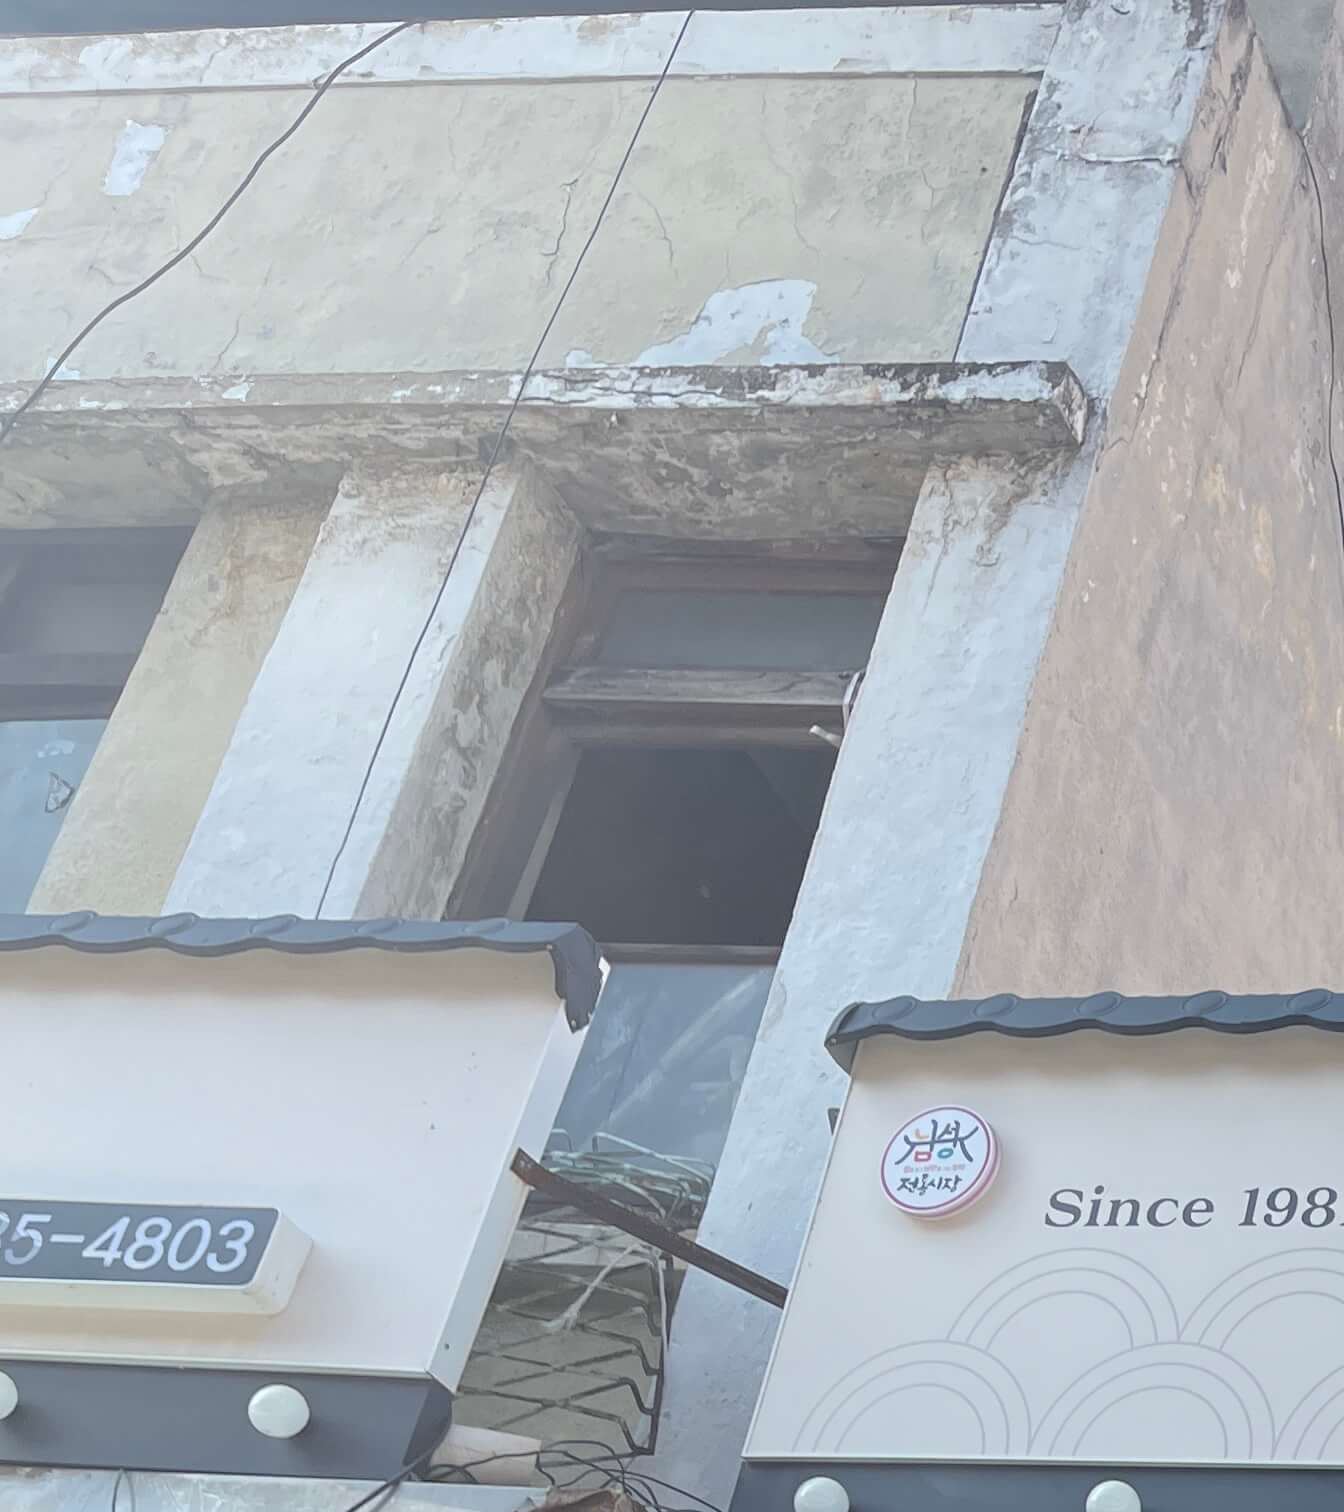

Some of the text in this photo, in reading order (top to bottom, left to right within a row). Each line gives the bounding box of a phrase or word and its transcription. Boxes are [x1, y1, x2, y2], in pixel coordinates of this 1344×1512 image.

[896, 1173, 963, 1197] 전통시장
[1044, 1184, 1214, 1228] Since
[0, 1210, 255, 1273] 5-4803
